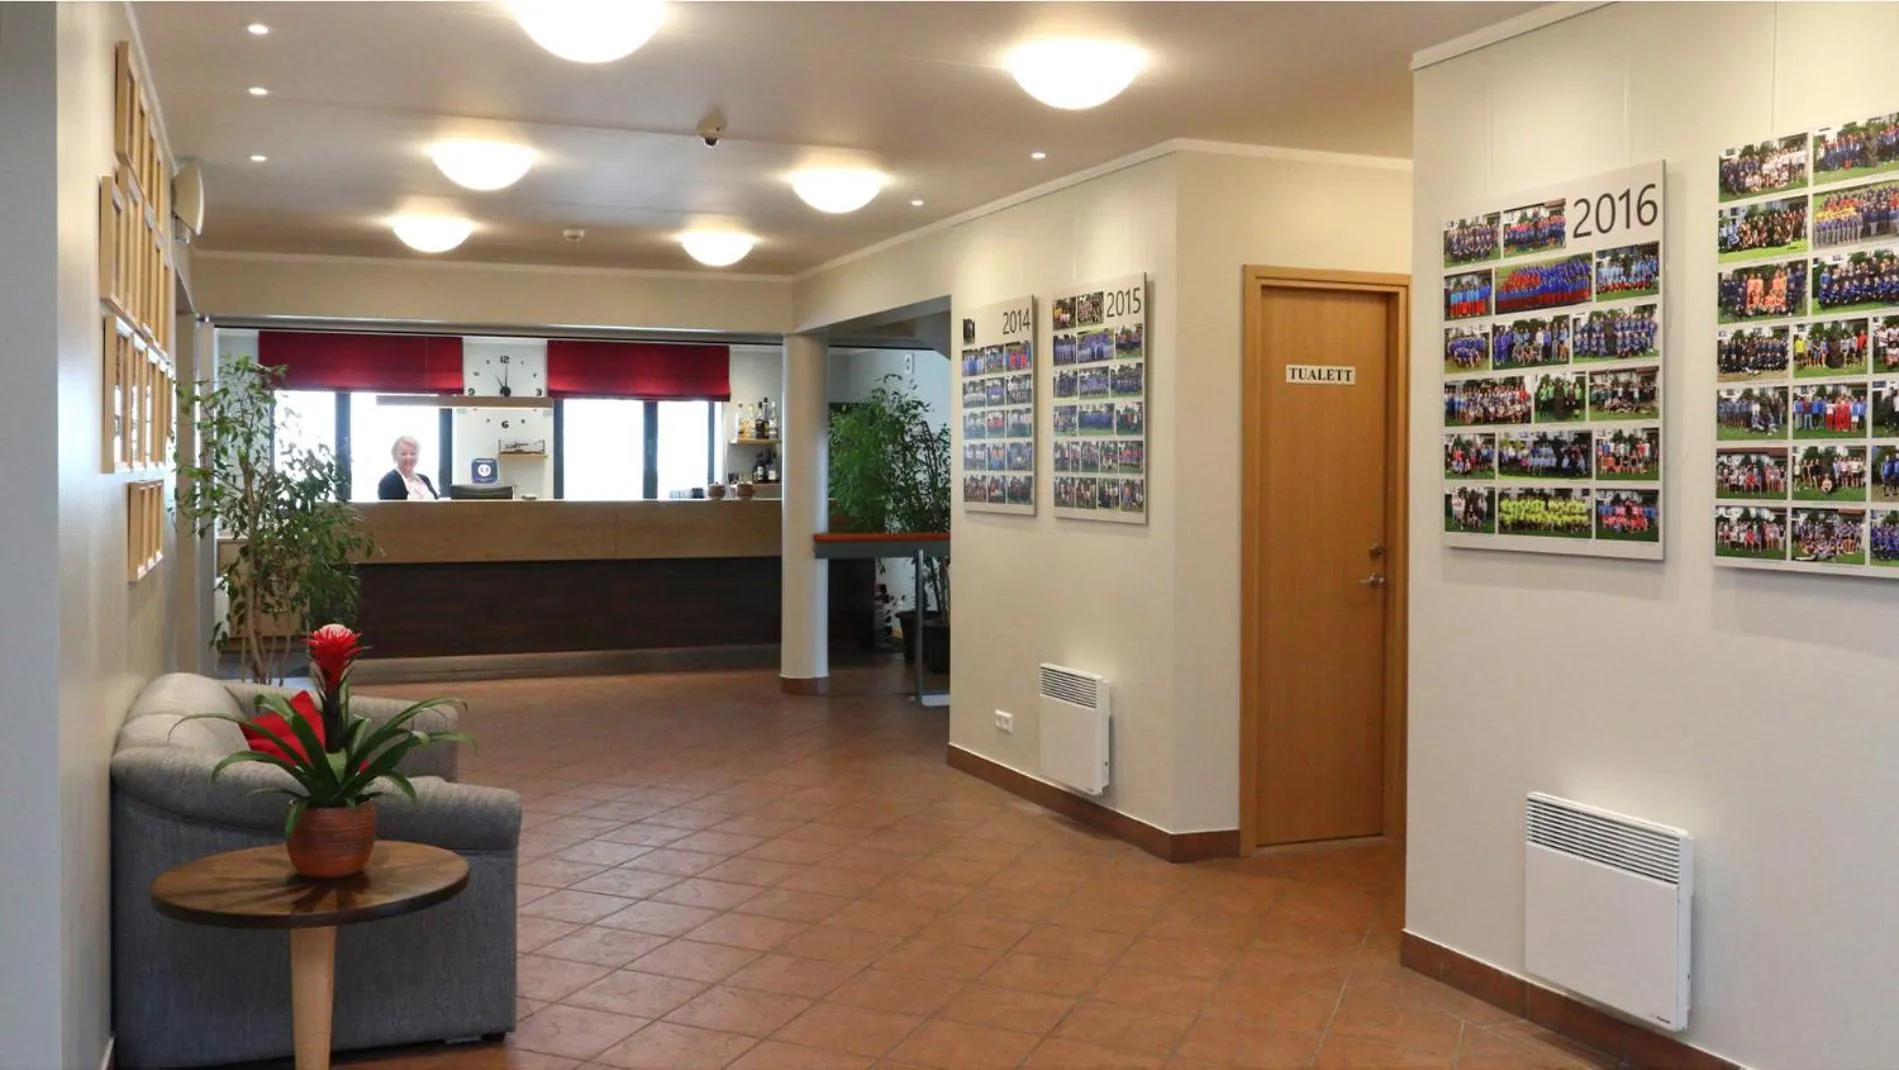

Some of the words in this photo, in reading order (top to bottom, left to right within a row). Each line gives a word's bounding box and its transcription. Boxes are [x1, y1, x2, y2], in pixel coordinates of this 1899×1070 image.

[1573, 183, 1658, 239] 2016
[1106, 287, 1141, 318] 2015
[1002, 307, 1030, 335] 2014
[500, 355, 510, 364] 12
[1289, 367, 1354, 382] TUALETT
[468, 388, 475, 396] 9
[501, 420, 509, 429] 6
